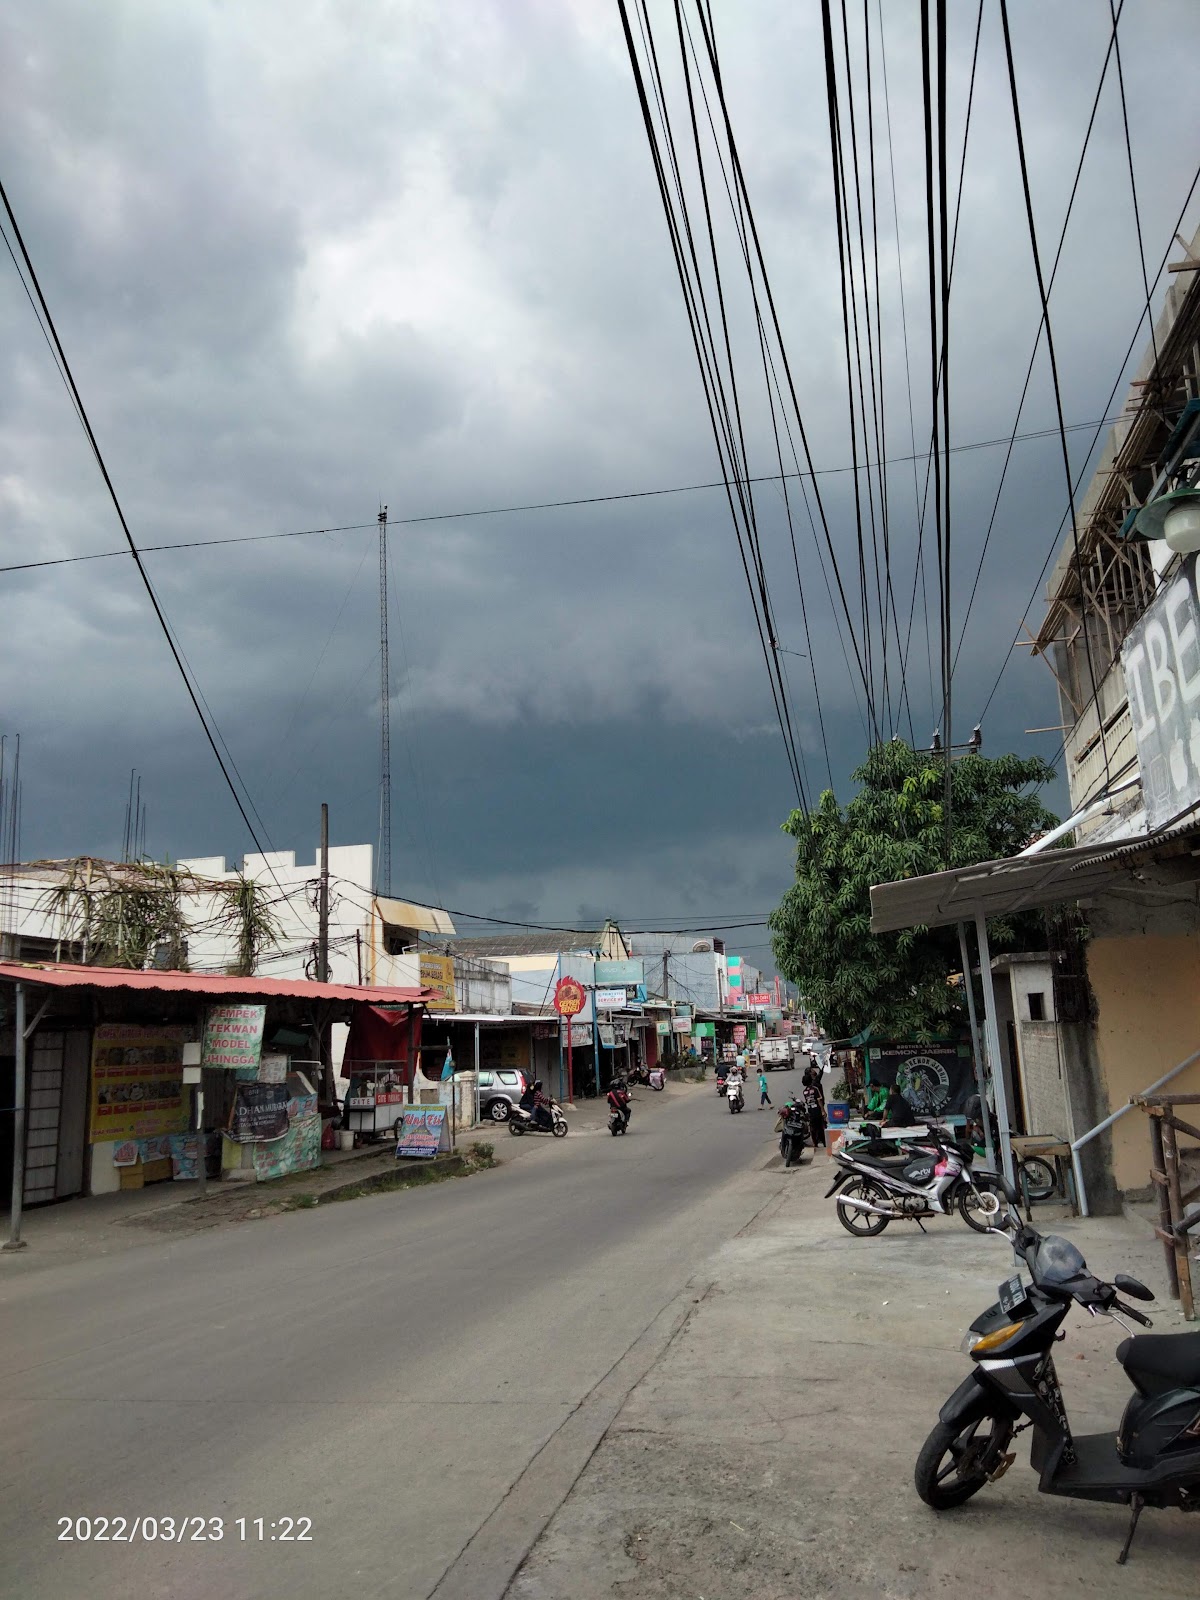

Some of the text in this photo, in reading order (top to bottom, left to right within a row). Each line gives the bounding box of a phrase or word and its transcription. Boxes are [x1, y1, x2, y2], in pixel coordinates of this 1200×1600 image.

[1126, 552, 1200, 743] IBE
[559, 1000, 581, 1008] GEPREK
[211, 1008, 258, 1018] PEMPEK
[561, 1005, 580, 1014] BENSU
[209, 1024, 258, 1034] TEKWAN
[212, 1040, 251, 1049] MODEL
[205, 1055, 255, 1064] JHINGGA
